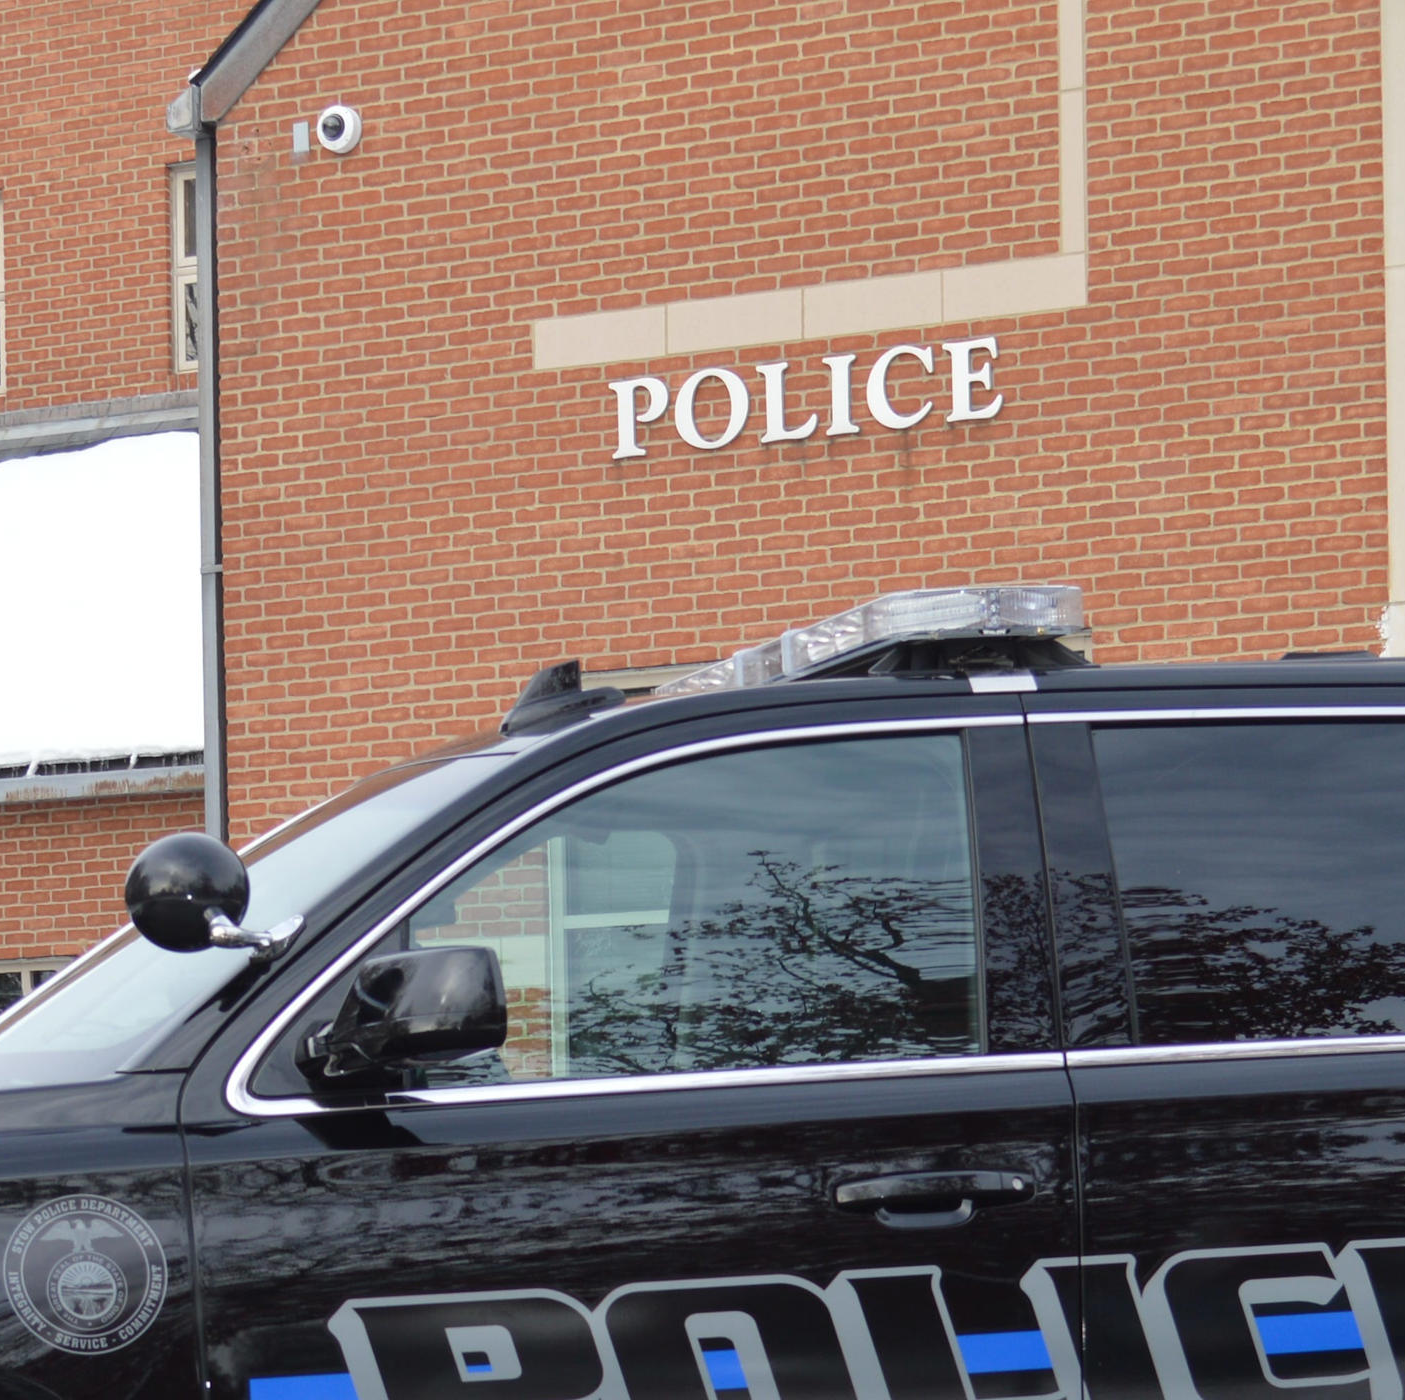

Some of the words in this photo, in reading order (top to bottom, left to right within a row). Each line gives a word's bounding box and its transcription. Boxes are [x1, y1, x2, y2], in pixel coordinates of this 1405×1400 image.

[607, 336, 1004, 460] POLICE
[11, 1222, 36, 1255] STOW
[34, 1199, 77, 1225] POLICE
[80, 1198, 155, 1247] DEPARTMENT
[7, 1271, 47, 1332] INTEGRITY
[54, 1332, 109, 1350] SERVICE
[117, 1264, 163, 1340] COMMITMENT
